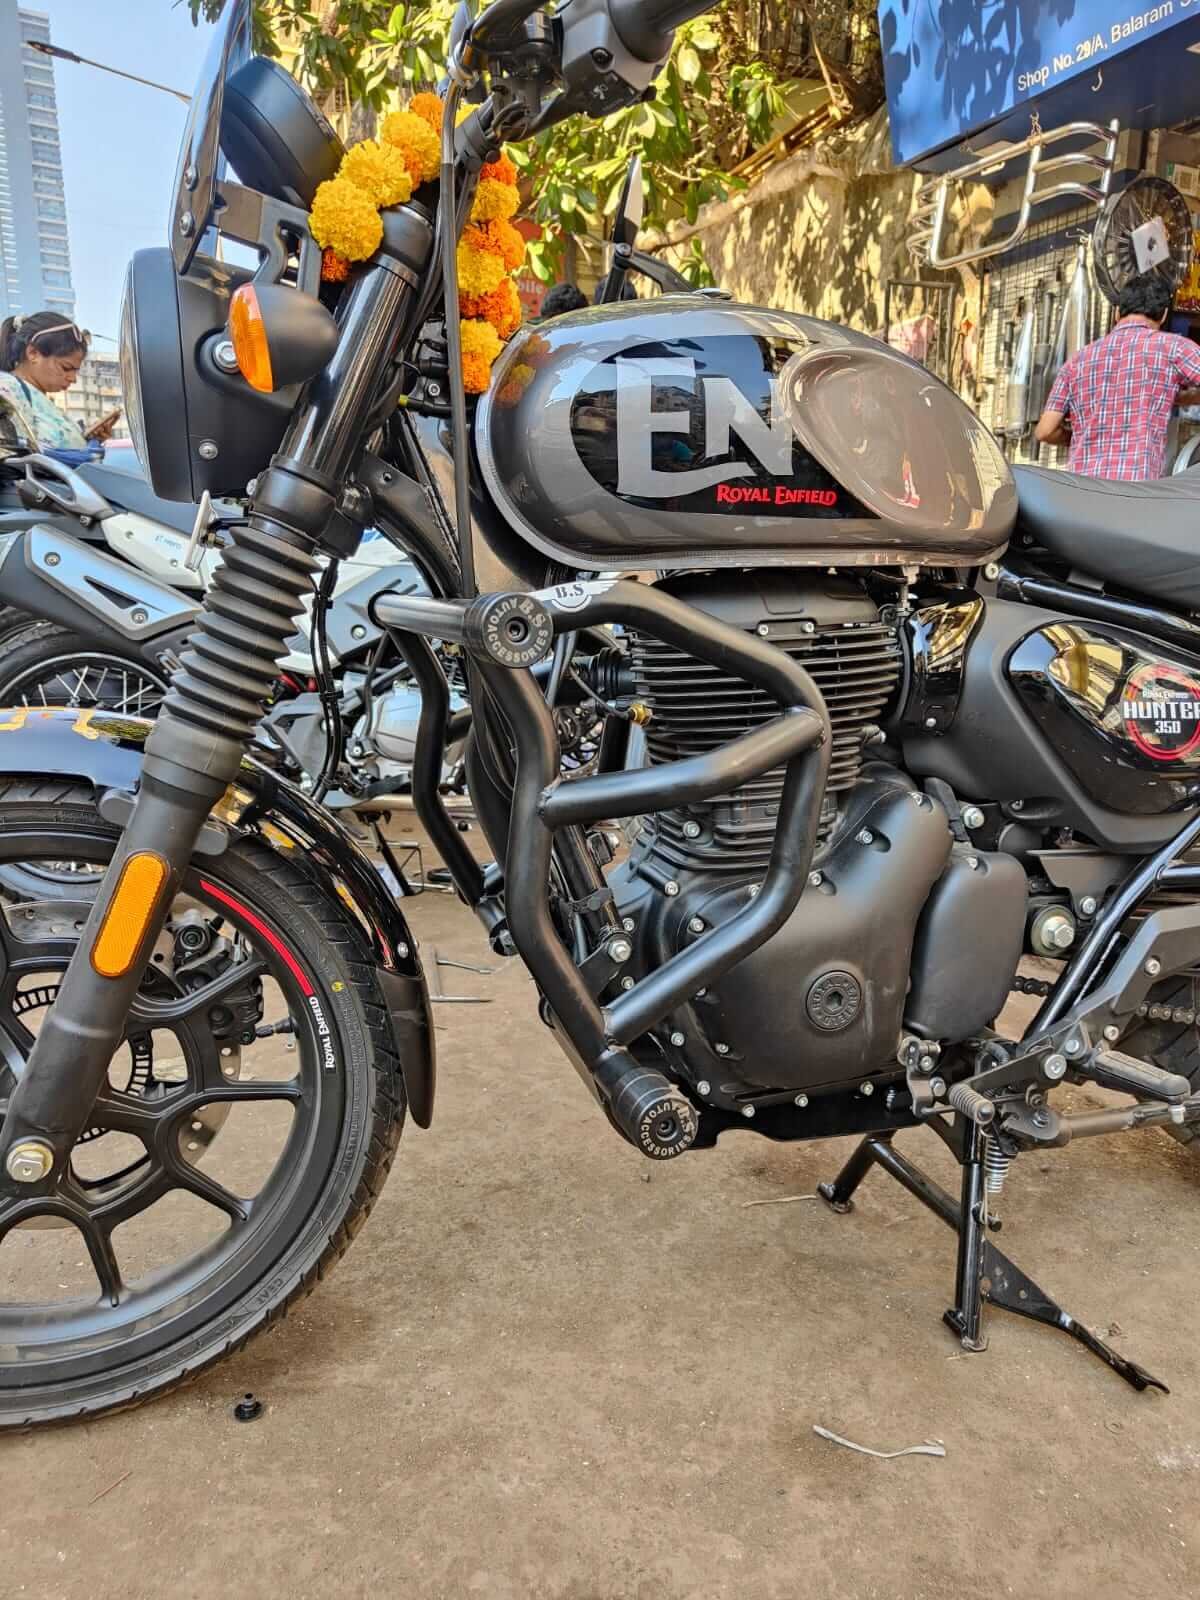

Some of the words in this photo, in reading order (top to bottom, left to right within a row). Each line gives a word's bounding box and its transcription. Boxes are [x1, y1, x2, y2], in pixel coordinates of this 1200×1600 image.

[1017, 66, 1049, 91] Shop
[1111, 1, 1173, 44] Balaram
[716, 484, 770, 504] ROYAL
[775, 484, 837, 506] ENFIELD
[555, 583, 584, 599] B.S
[1155, 720, 1181, 734] 350
[309, 996, 330, 1035] ENFIELD
[322, 1036, 335, 1069] ROYAL
